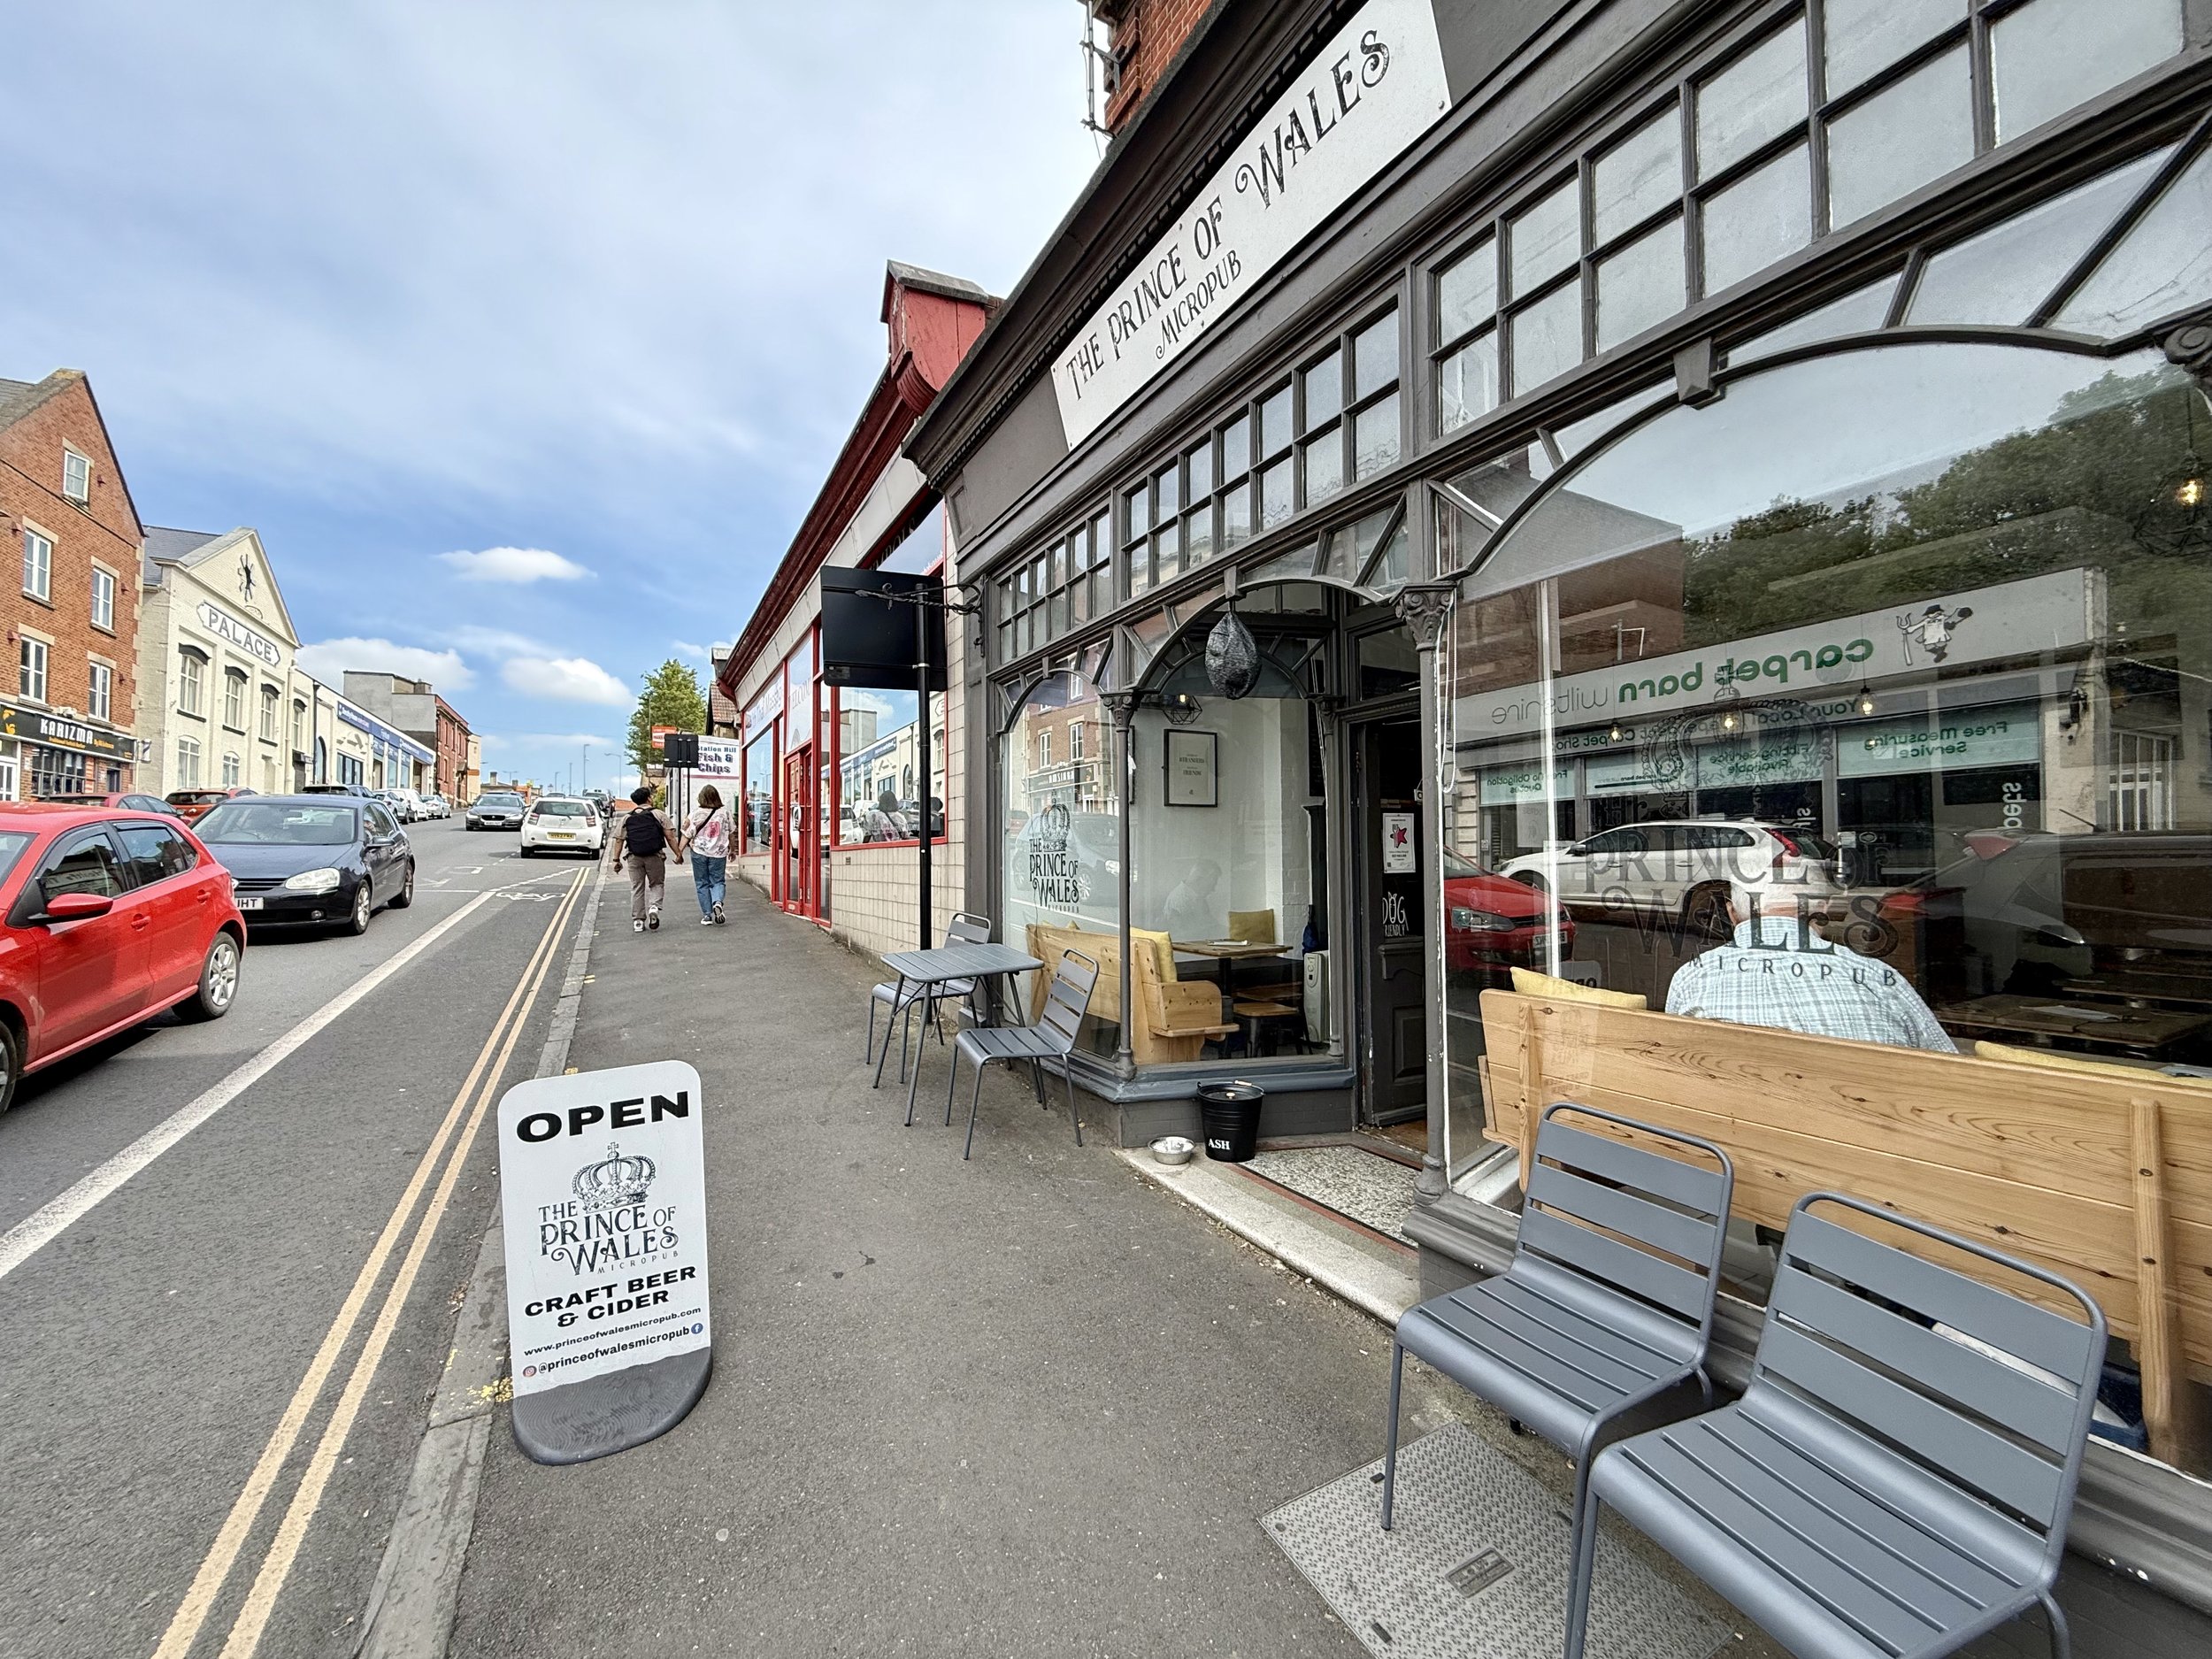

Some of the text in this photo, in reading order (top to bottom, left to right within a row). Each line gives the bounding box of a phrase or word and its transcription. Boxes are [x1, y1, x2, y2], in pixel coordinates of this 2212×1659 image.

[1065, 28, 1393, 402] THE PRINCE OF WALES
[1155, 249, 1242, 360] MICROPUB
[209, 608, 272, 662] PALACE
[40, 718, 94, 745] KARIZMA
[698, 752, 722, 763] Fish
[698, 763, 732, 774] Chips
[1029, 838, 1042, 853] THE
[1585, 826, 1811, 894] PRINCE
[1029, 853, 1079, 882] PRINCE OF
[1033, 878, 1079, 907] WALES
[1385, 925, 1406, 937] RIENDLY
[1601, 885, 1900, 959] WALES
[1688, 952, 1899, 987] MICROPUB
[516, 1090, 690, 1144] OPEN
[1208, 1138, 1231, 1150] ASH
[538, 1199, 579, 1224] THE
[540, 1204, 678, 1256] PRINCE OF
[550, 1225, 680, 1277] WALES
[596, 1249, 680, 1274] MICROPUB
[524, 1265, 697, 1318] CRAFT BEER
[557, 1289, 670, 1328] & CIDER
[524, 1306, 703, 1357] www.princeofwalesmicropub.com
[538, 1325, 690, 1375] @princeofwalesmicropub
